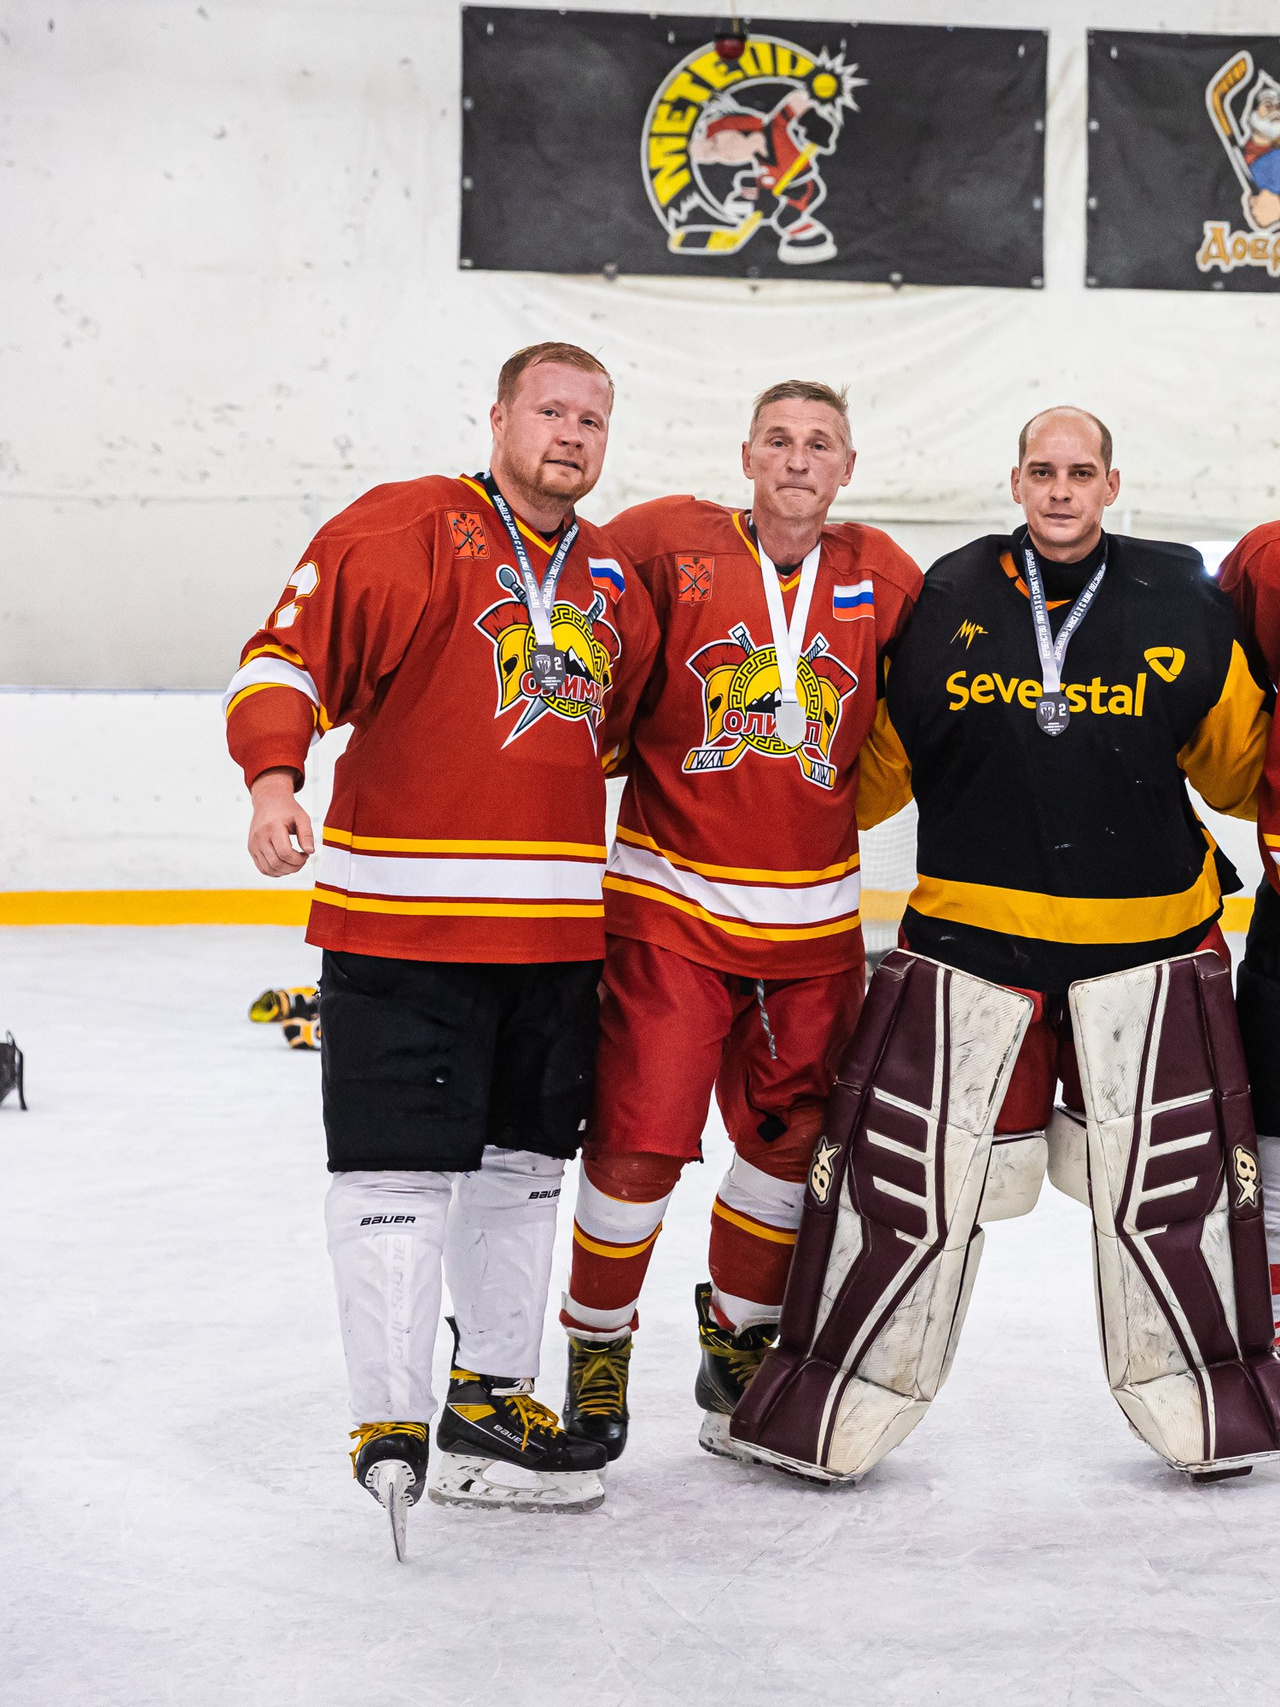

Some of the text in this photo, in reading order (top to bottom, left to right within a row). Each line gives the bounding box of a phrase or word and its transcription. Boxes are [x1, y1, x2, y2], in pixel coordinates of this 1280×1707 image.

[553, 656, 563, 671] 2
[1058, 702, 1067, 717] 2
[723, 709, 823, 745] ОЛИП
[359, 1214, 417, 1227] BAUER
